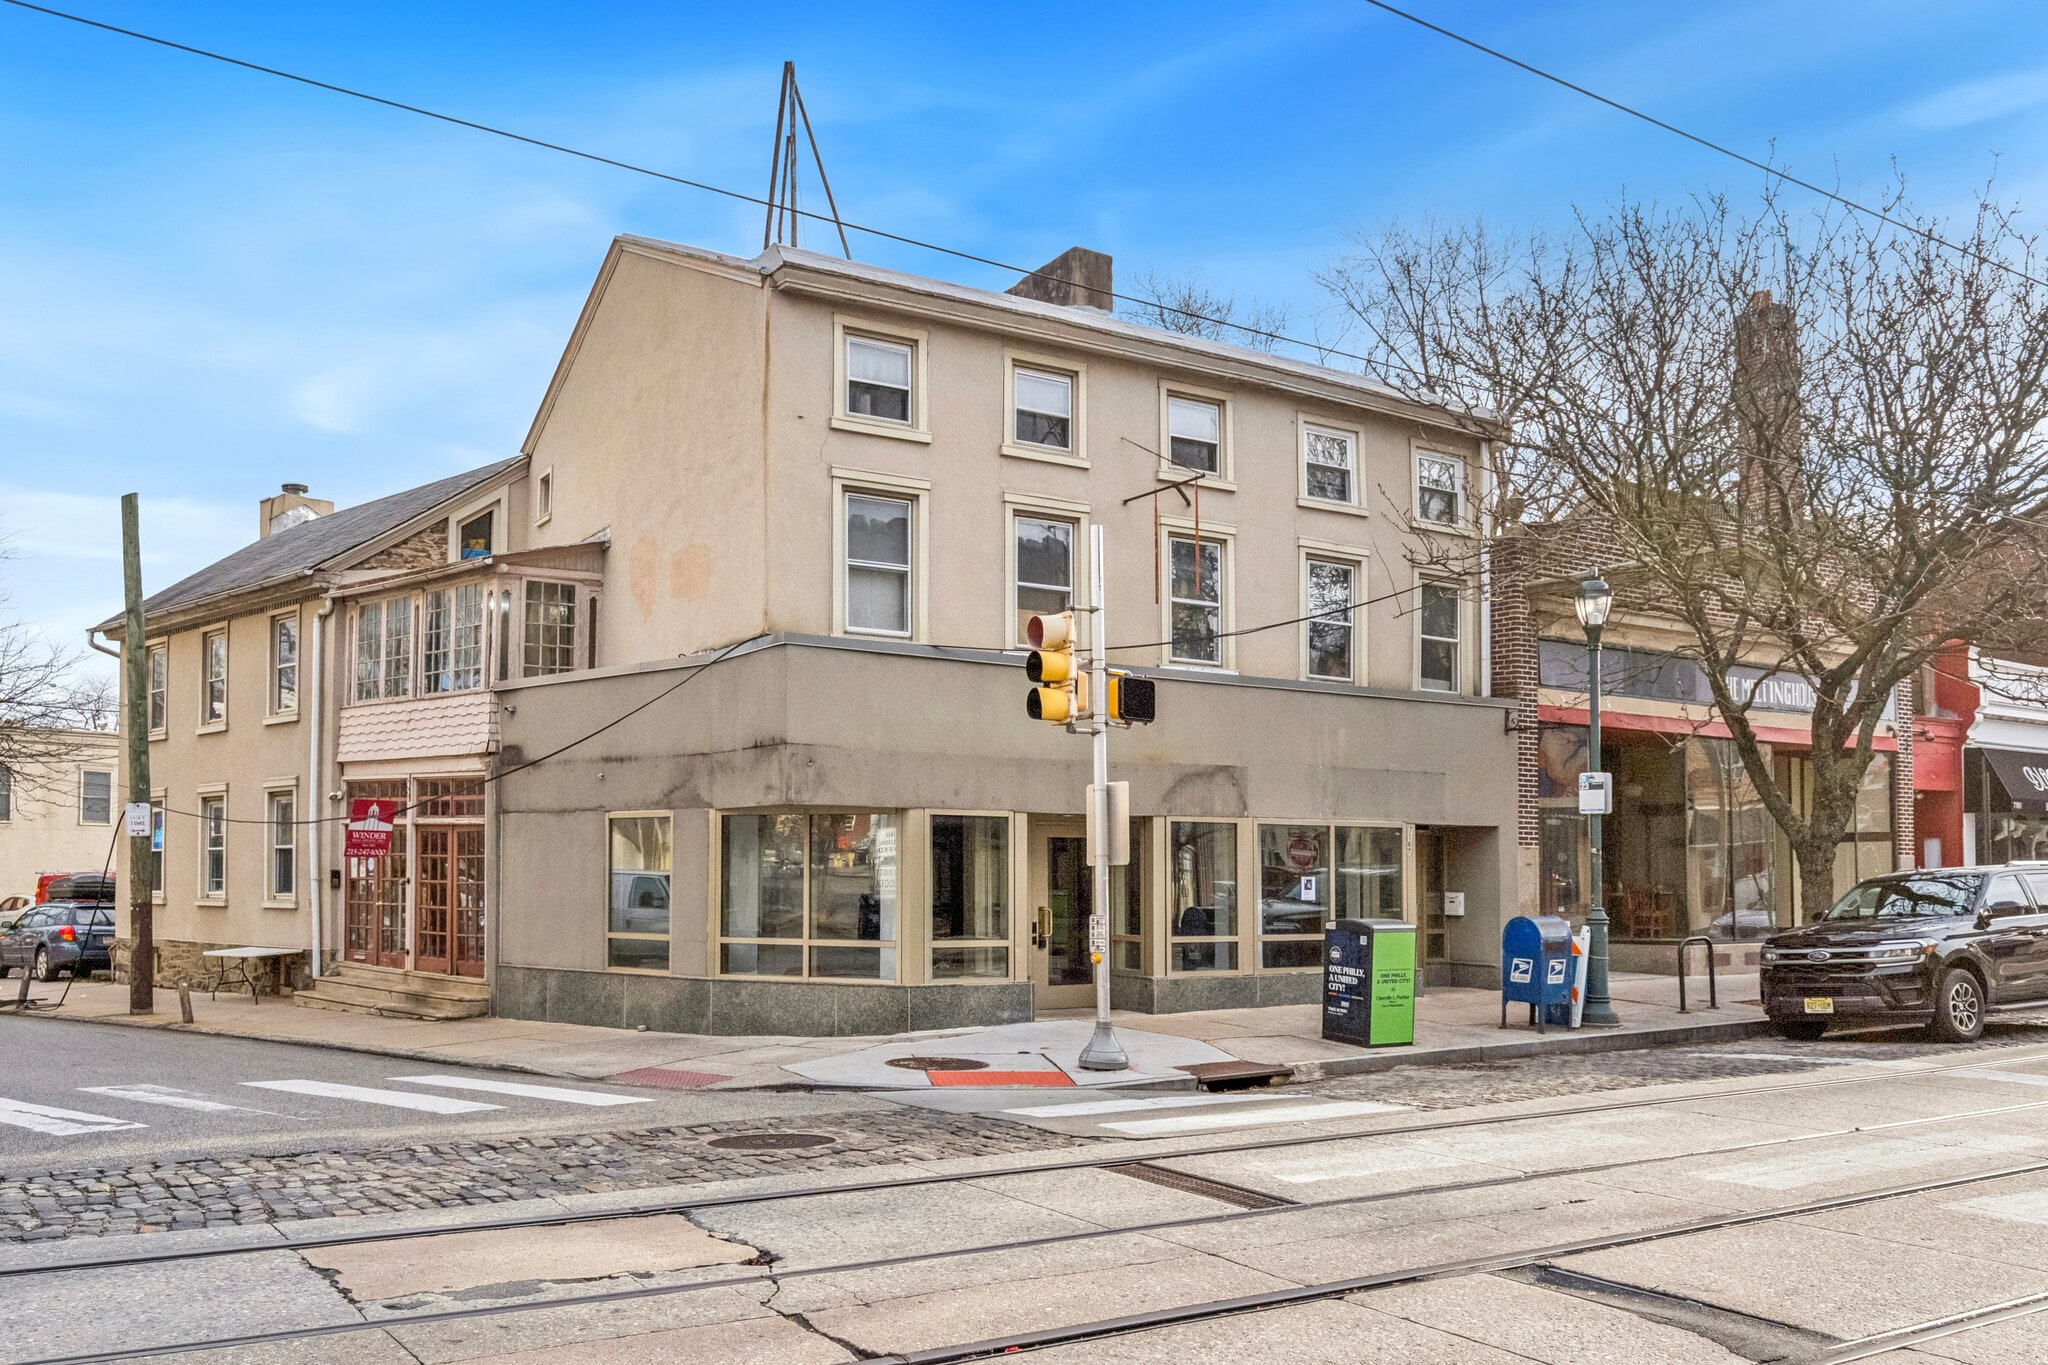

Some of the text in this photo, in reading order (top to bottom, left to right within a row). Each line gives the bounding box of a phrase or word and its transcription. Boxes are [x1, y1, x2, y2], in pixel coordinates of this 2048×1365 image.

[1726, 676, 1818, 707] HE MEETINGHOUS
[352, 831, 387, 840] WINDER
[1328, 965, 1365, 978] ONE PHILLY,
[1328, 974, 1358, 985] A UNITED
[1328, 982, 1346, 992] CITY!
